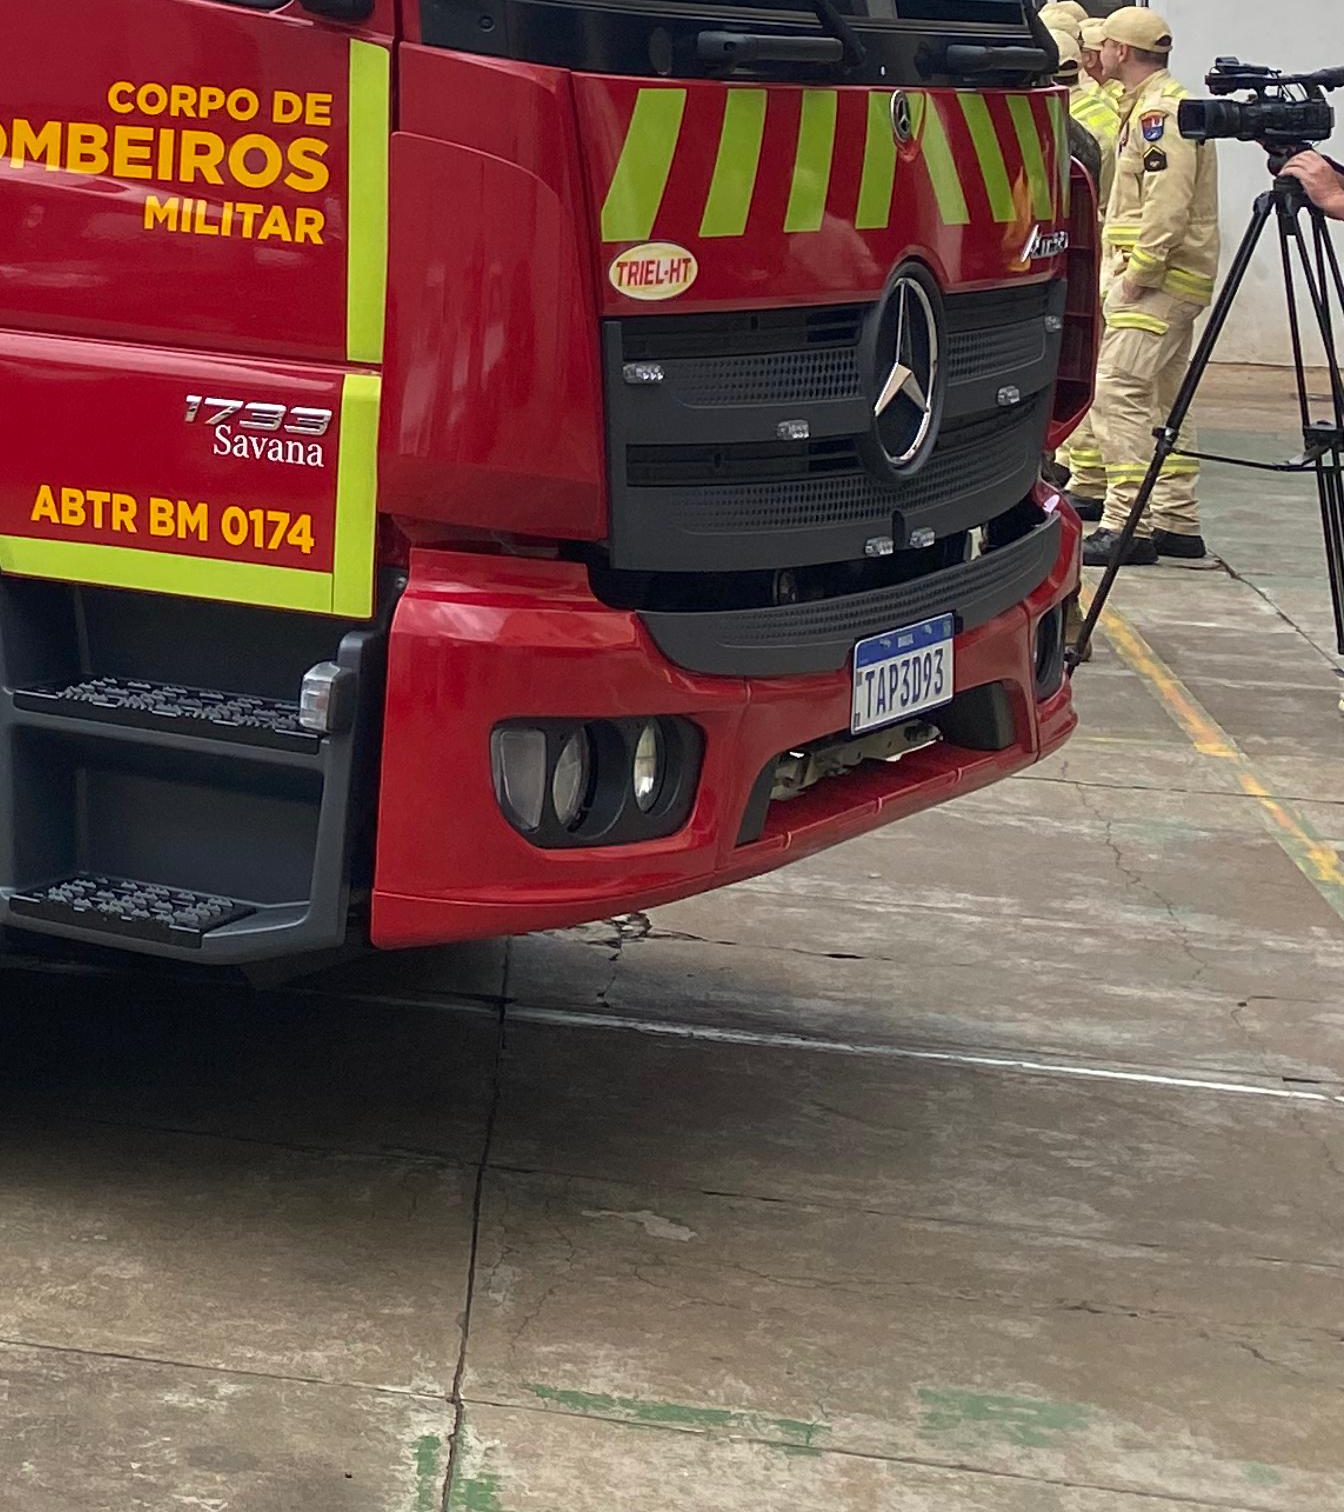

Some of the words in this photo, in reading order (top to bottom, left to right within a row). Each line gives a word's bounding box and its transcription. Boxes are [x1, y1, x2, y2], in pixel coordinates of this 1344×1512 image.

[107, 80, 259, 121] CORPO
[273, 92, 333, 126] DE
[143, 195, 325, 244] MILITAR
[616, 257, 692, 286] TRIEL-HT
[184, 394, 332, 435] 1733
[213, 424, 324, 467] Savana
[30, 484, 137, 534] ABTR
[149, 497, 208, 542] BM
[220, 505, 315, 554] 0174
[864, 649, 944, 718] TAP3D93
